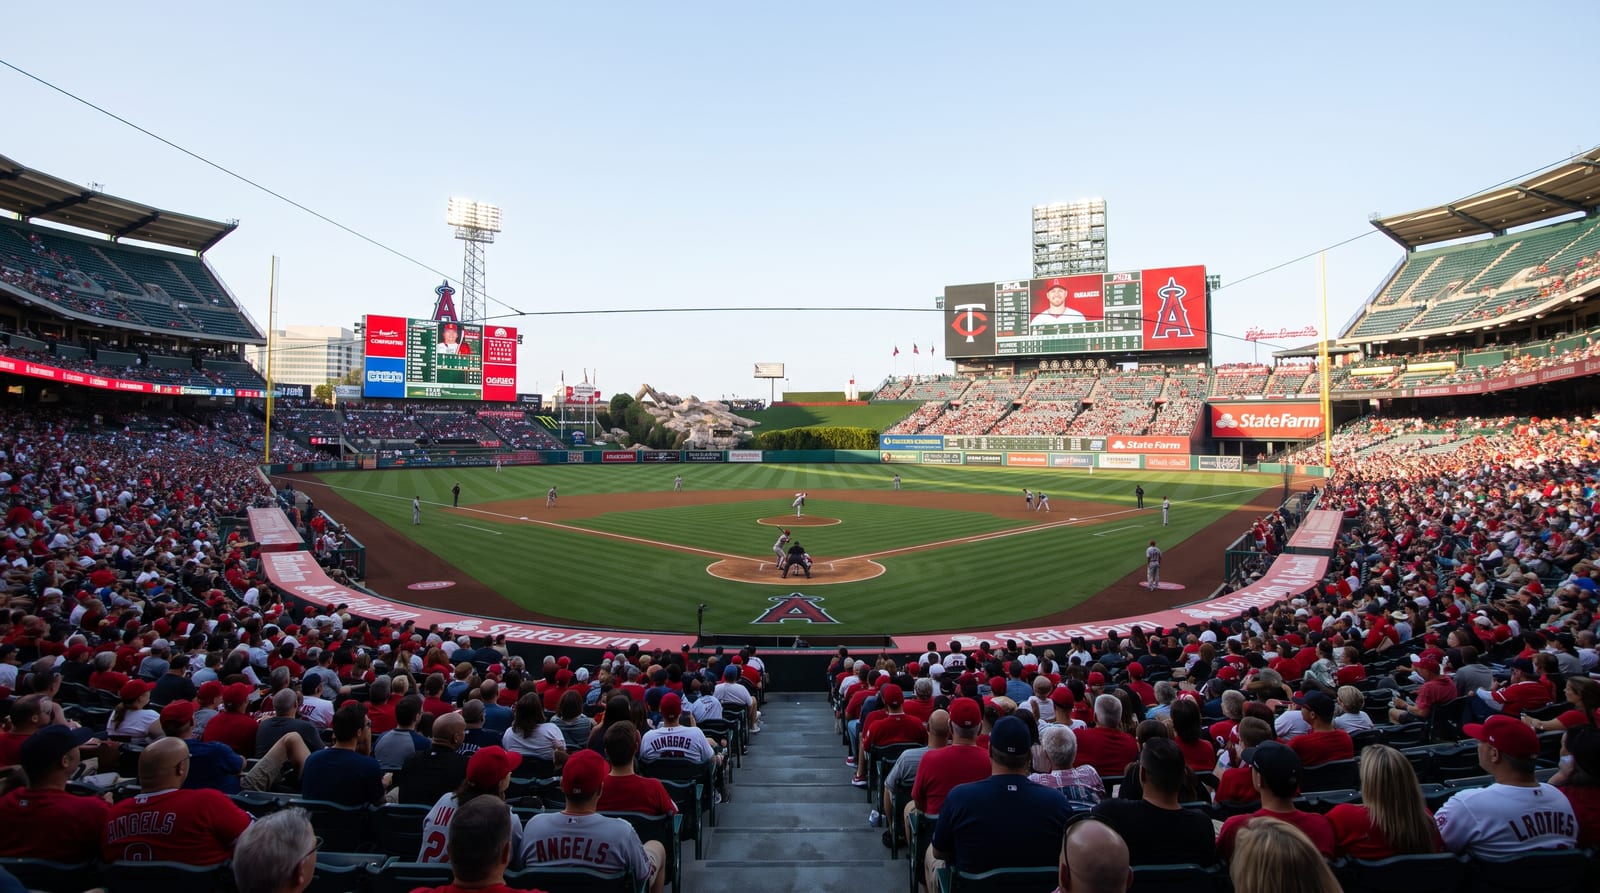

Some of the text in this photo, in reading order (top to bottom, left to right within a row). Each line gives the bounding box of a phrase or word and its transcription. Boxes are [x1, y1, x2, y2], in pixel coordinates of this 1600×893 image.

[1152, 277, 1195, 338] A
[1127, 440, 1180, 449] State Farm
[108, 811, 176, 844] ANGELS
[536, 836, 609, 864] ANGELS
